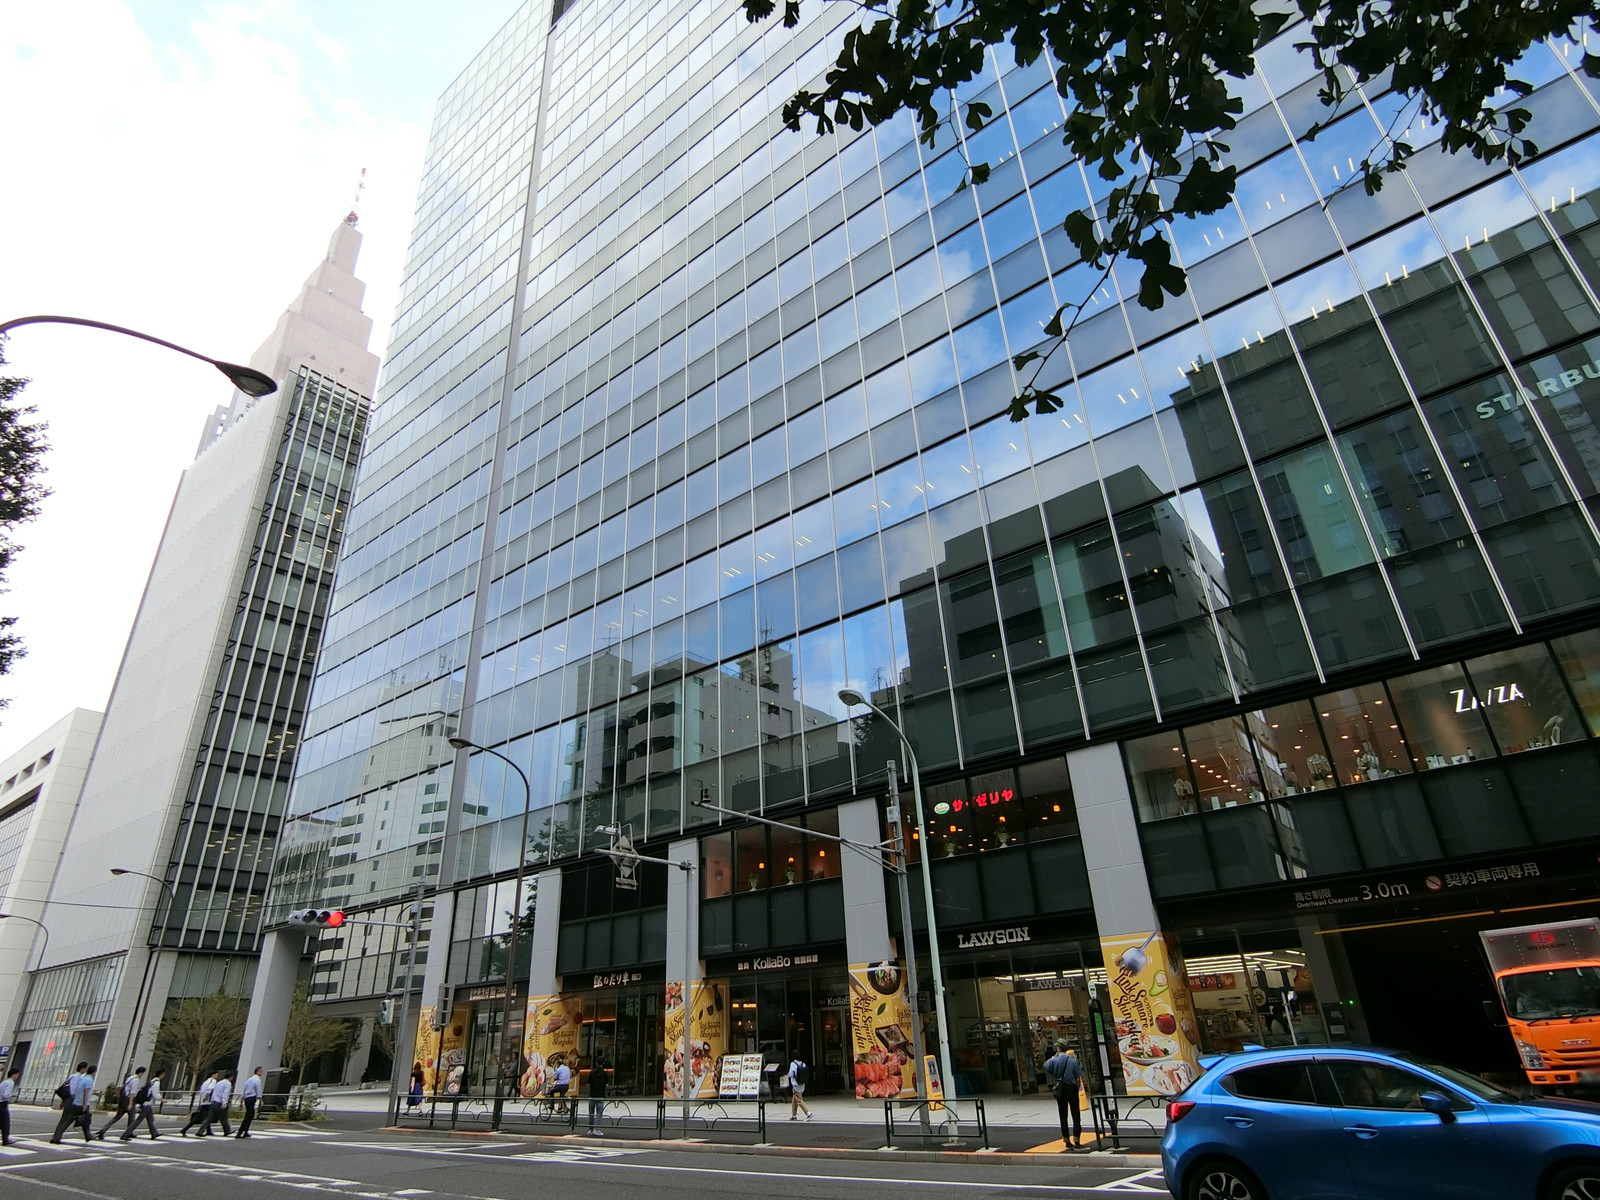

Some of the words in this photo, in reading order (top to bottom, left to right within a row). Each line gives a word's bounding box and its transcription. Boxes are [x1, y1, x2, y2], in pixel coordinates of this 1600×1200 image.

[1475, 360, 1600, 419] STARBU
[952, 789, 1014, 812] サゼリヤ
[1444, 862, 1540, 888] 契約車両専用
[1294, 888, 1332, 902] 高さ制限
[1296, 898, 1327, 909] Overhead
[1328, 895, 1359, 905] Clearance
[1360, 882, 1410, 900] 3.0m
[957, 926, 1031, 948] LAWSON
[753, 955, 791, 970] KollaBo
[1029, 978, 1076, 990] LAWSON
[827, 995, 850, 1006] KollaB
[1113, 966, 1141, 996] Link
[1129, 989, 1149, 1030] Square
[851, 997, 867, 1049] Shinjuku
[861, 1014, 876, 1047] Squar
[1113, 995, 1142, 1046] Shinjuku
[2, 1047, 9, 1055] P
